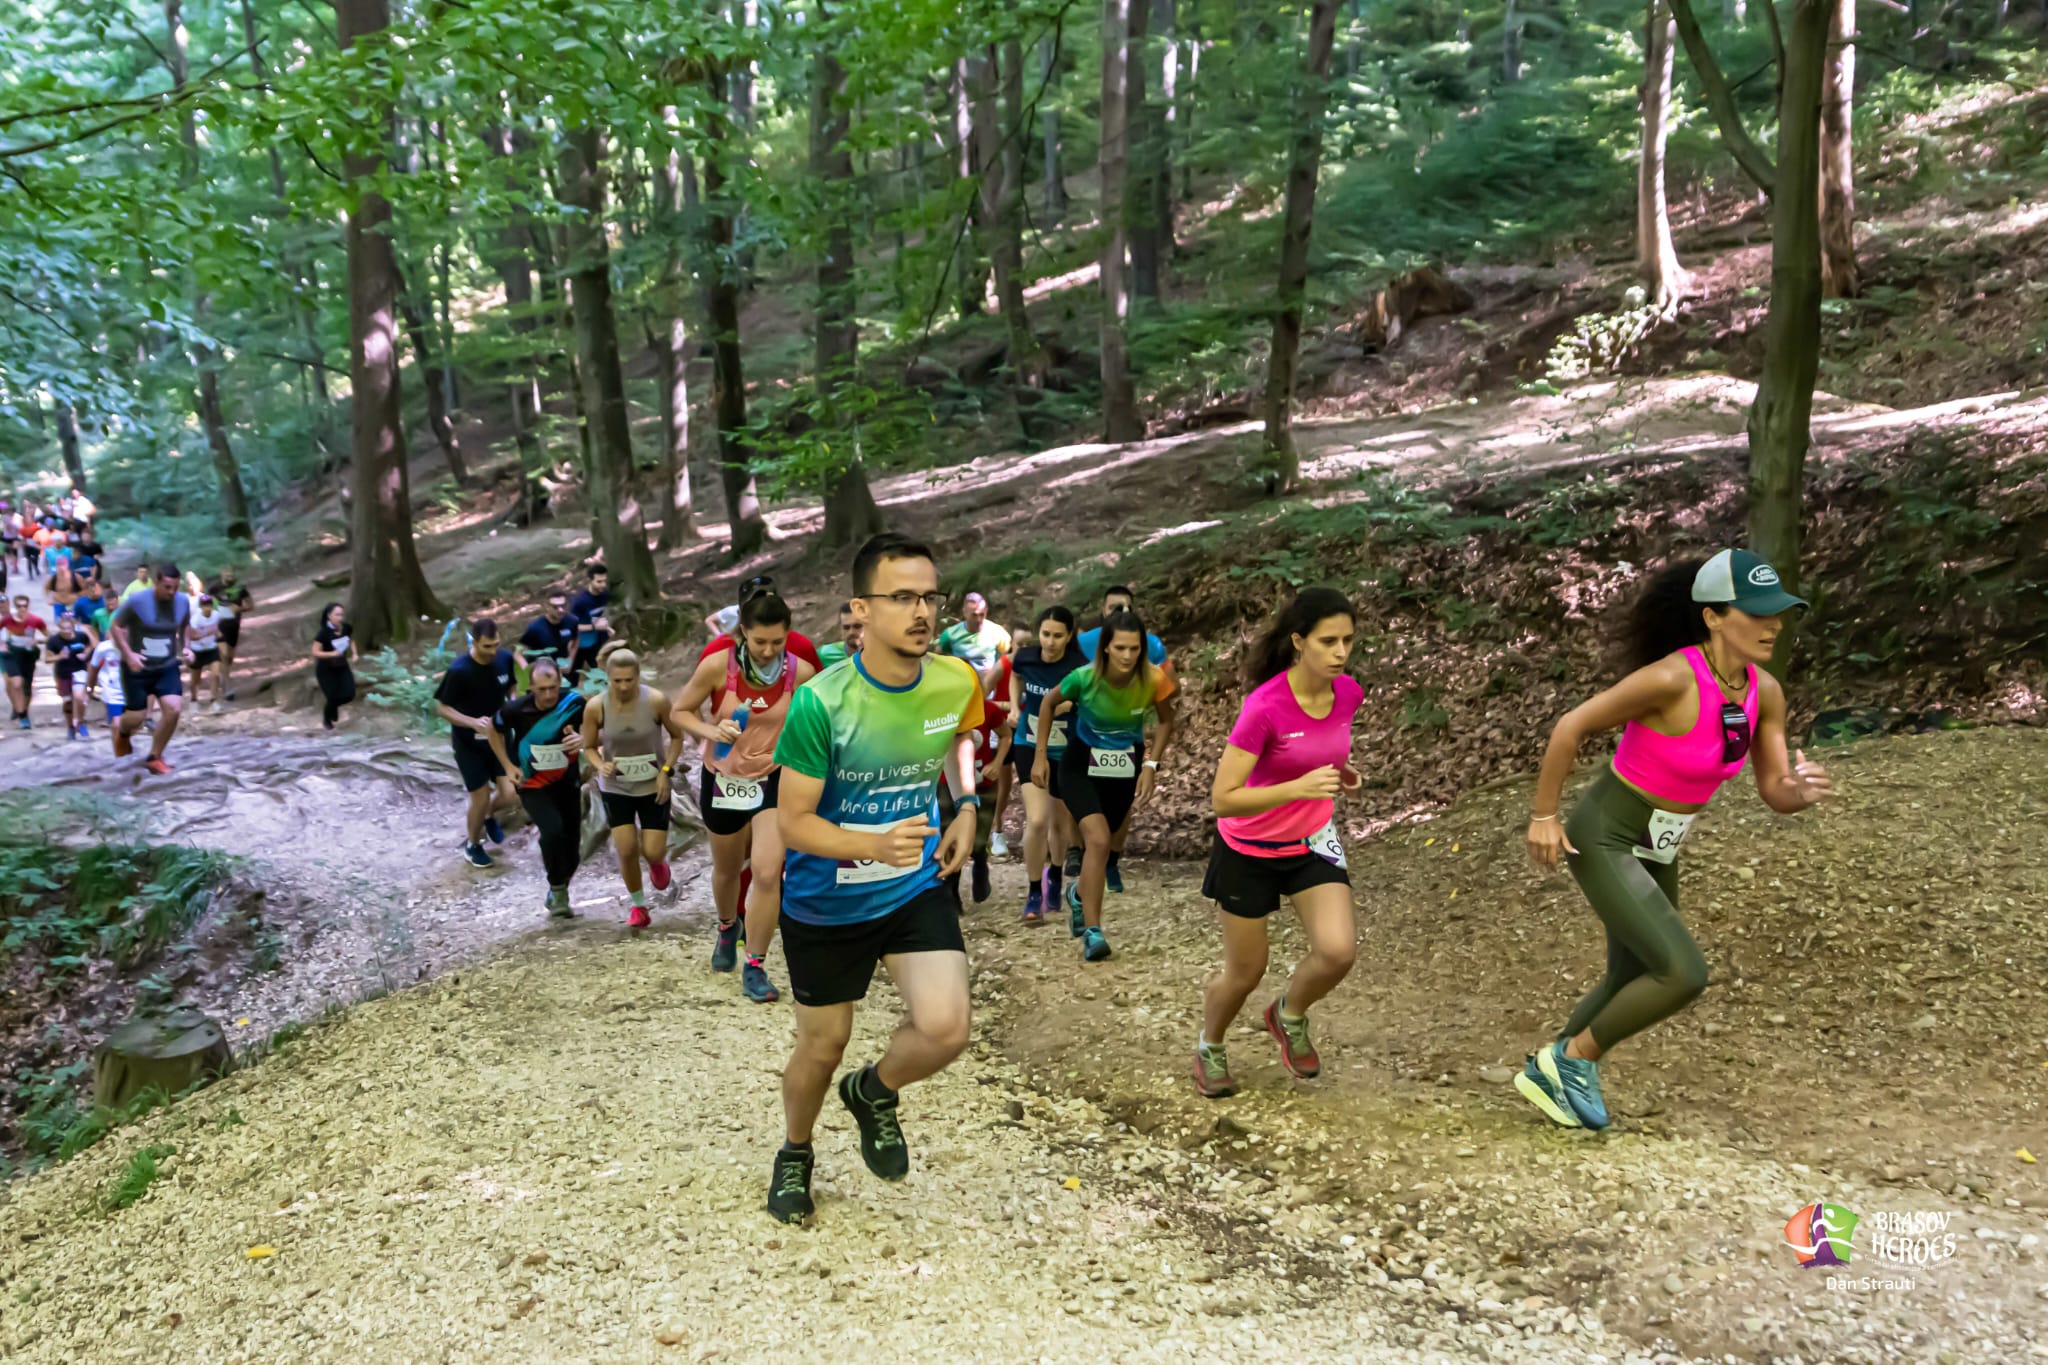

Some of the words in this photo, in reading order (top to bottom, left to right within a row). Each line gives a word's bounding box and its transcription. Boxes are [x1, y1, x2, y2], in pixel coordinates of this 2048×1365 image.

[923, 712, 960, 730] Autoliv
[1100, 754, 1127, 767] 636
[624, 764, 649, 775] 720
[835, 766, 875, 783] More
[879, 764, 921, 781] Lives
[726, 783, 757, 799] 663
[883, 796, 910, 813] Life
